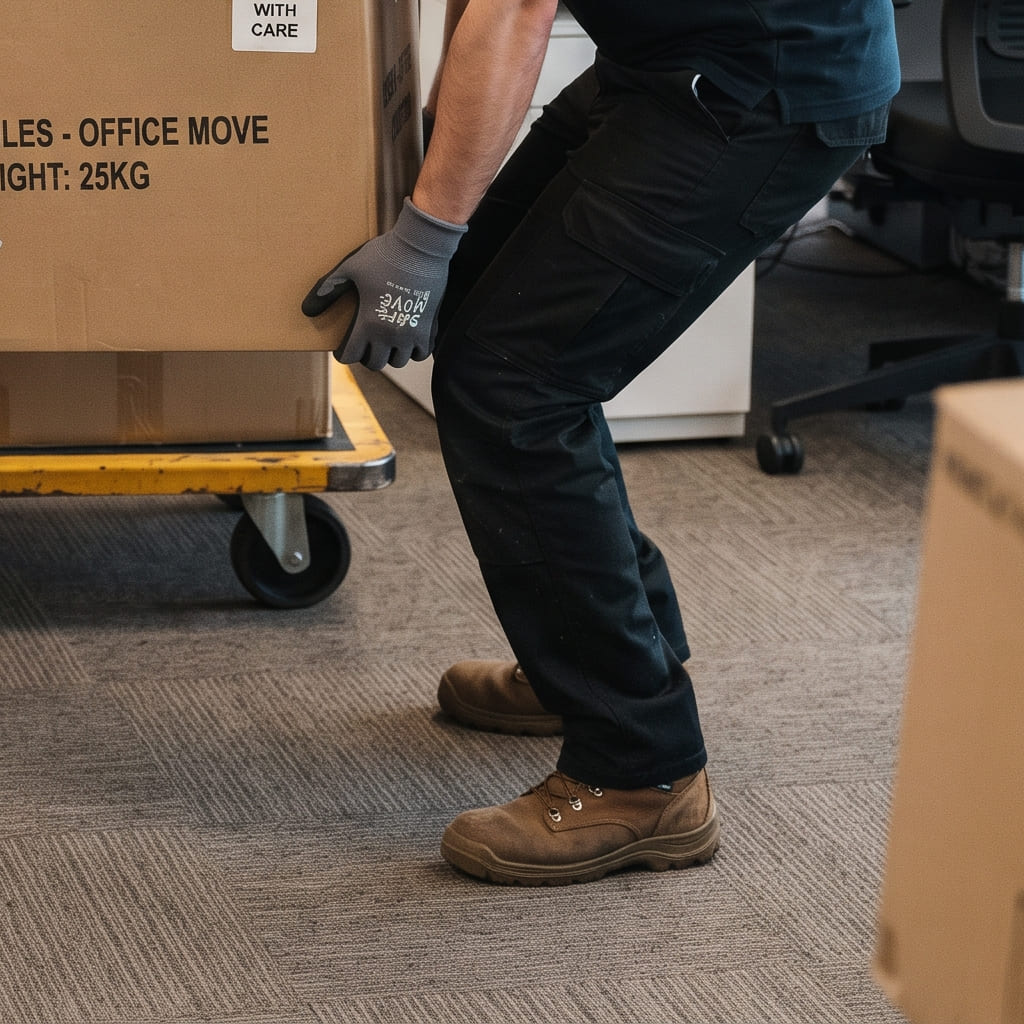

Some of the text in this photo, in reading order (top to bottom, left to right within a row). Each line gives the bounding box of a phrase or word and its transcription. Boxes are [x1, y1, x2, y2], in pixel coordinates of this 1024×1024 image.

[253, 3, 297, 17] WITH
[251, 22, 299, 38] CARE
[78, 116, 179, 147] OFFICE
[188, 114, 270, 146] MOVE
[79, 160, 151, 191] 25KG
